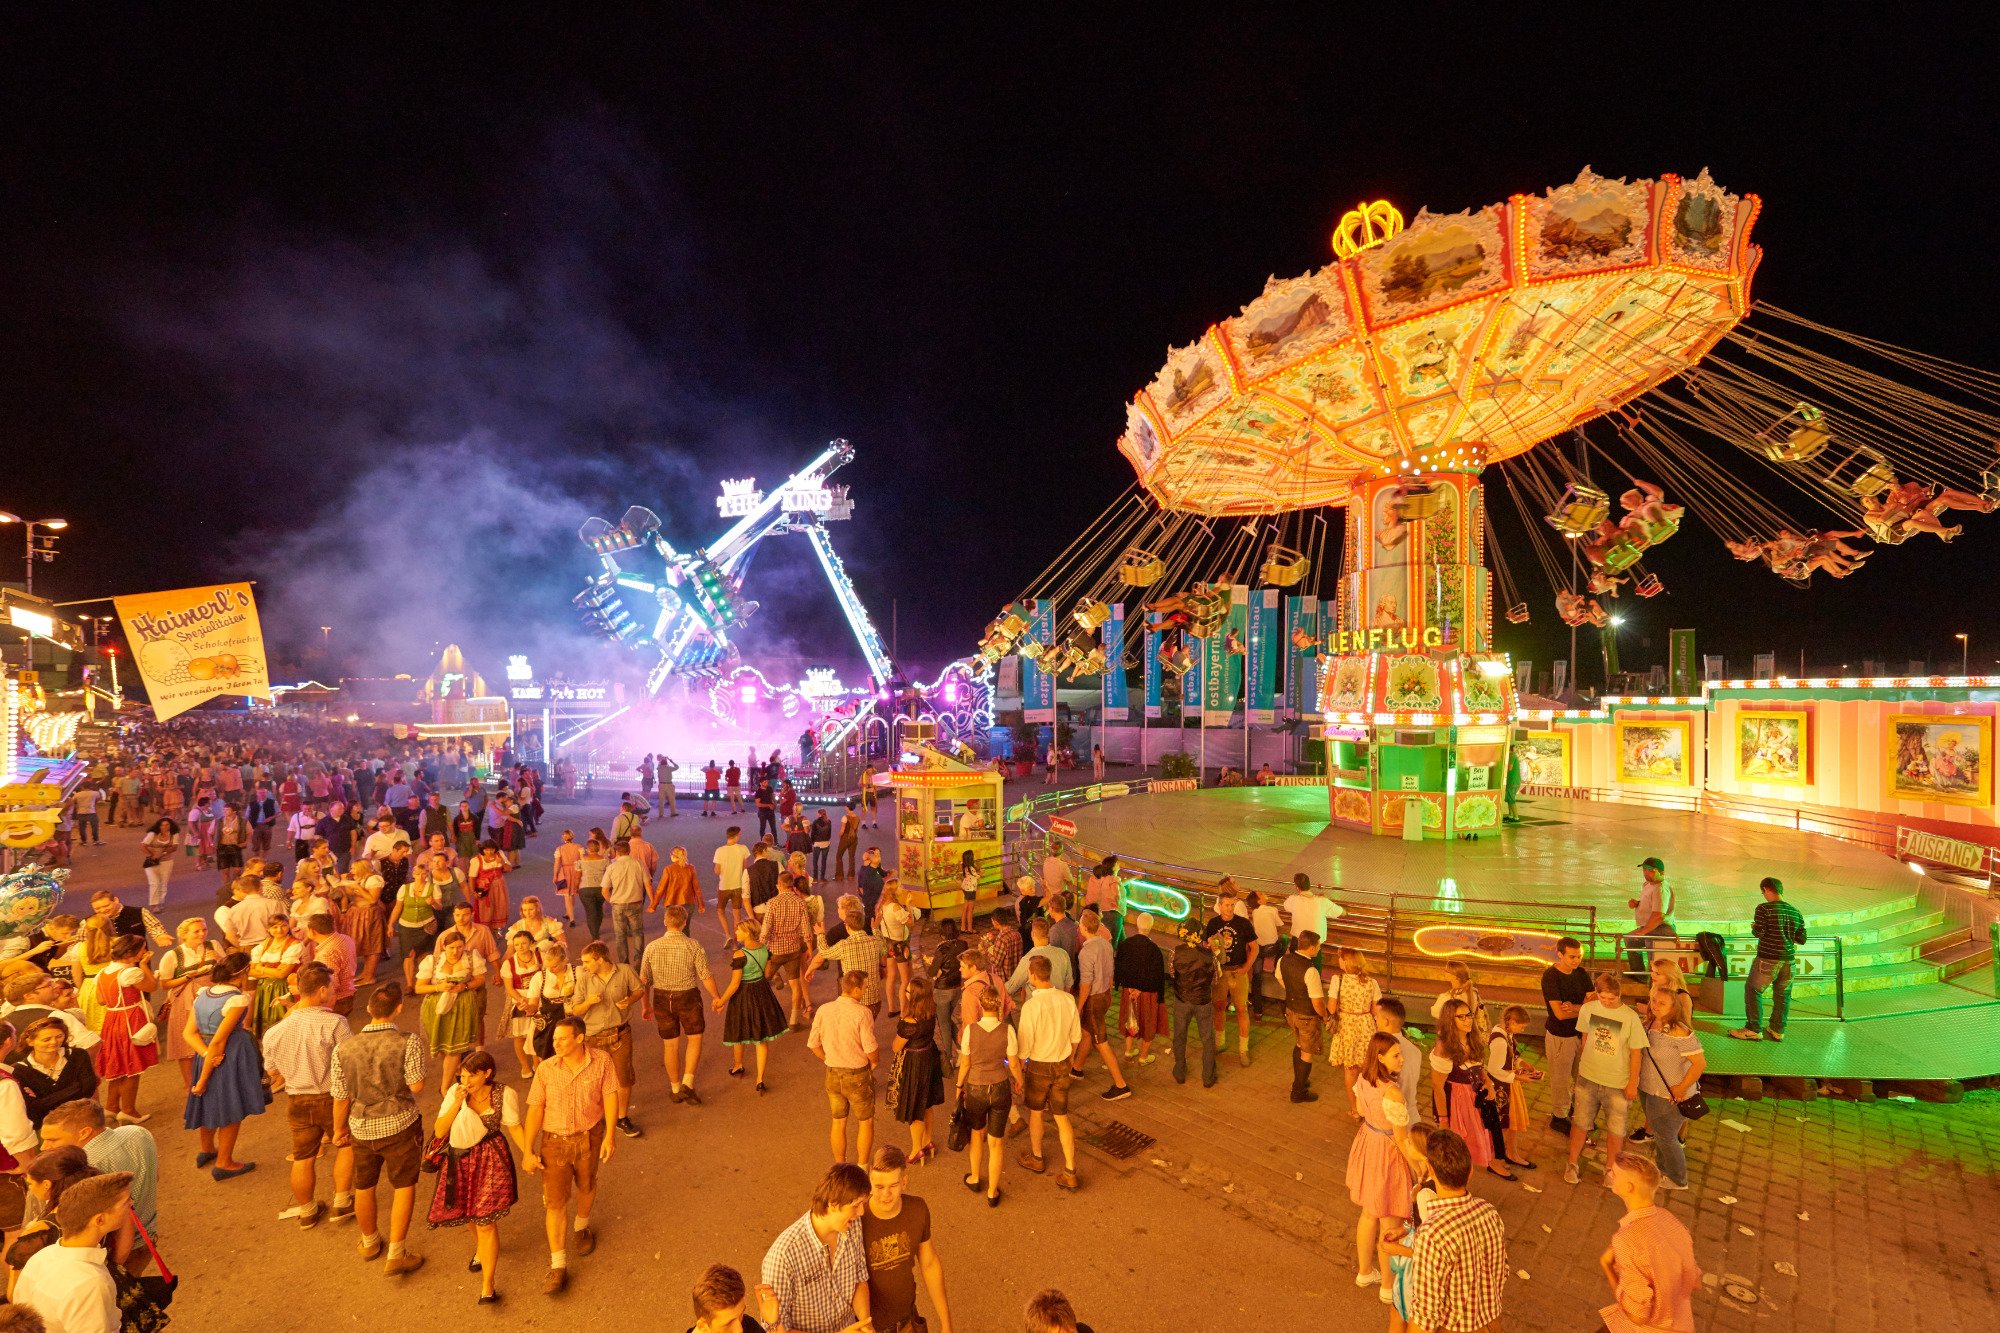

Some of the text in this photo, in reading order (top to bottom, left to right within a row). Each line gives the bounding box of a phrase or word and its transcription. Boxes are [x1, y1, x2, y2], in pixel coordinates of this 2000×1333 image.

[717, 492, 758, 517] THE
[781, 489, 832, 511] KING
[131, 588, 249, 641] Haimerl's
[177, 612, 246, 643] Spezialitäten
[1249, 605, 1260, 706] ostbayernchau
[25, 672, 33, 681] B
[160, 692, 175, 700] wir
[179, 684, 224, 697] versüßen
[226, 681, 251, 689] Ihren
[576, 688, 605, 699] HOT
[1529, 786, 1590, 799] AUSGANG
[1053, 820, 1077, 835] Eingang
[1907, 833, 1971, 868] AUSGANG
